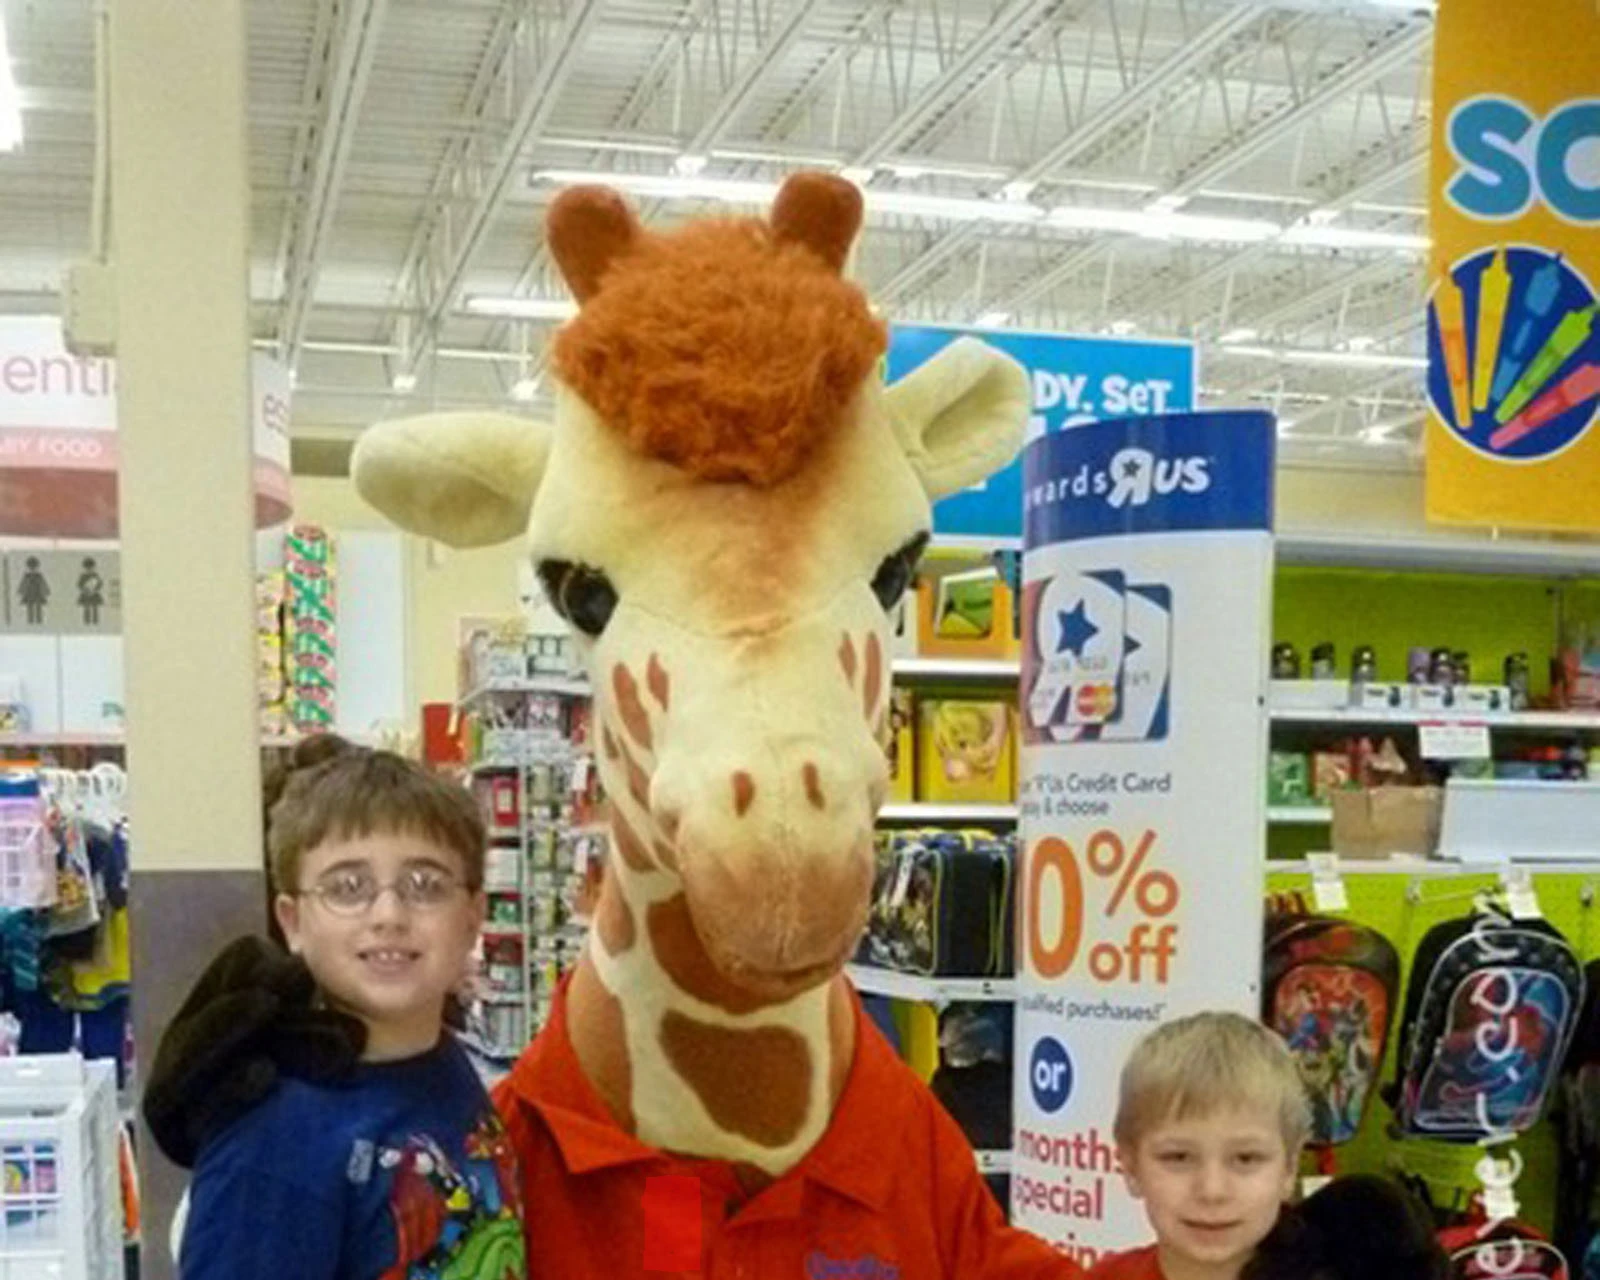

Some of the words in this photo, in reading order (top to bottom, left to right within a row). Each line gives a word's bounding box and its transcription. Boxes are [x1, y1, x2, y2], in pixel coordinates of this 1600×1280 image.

[1067, 772, 1117, 793] Credit
[1122, 772, 1171, 793] Card
[1089, 924, 1177, 983] off
[1034, 1060, 1066, 1091] or
